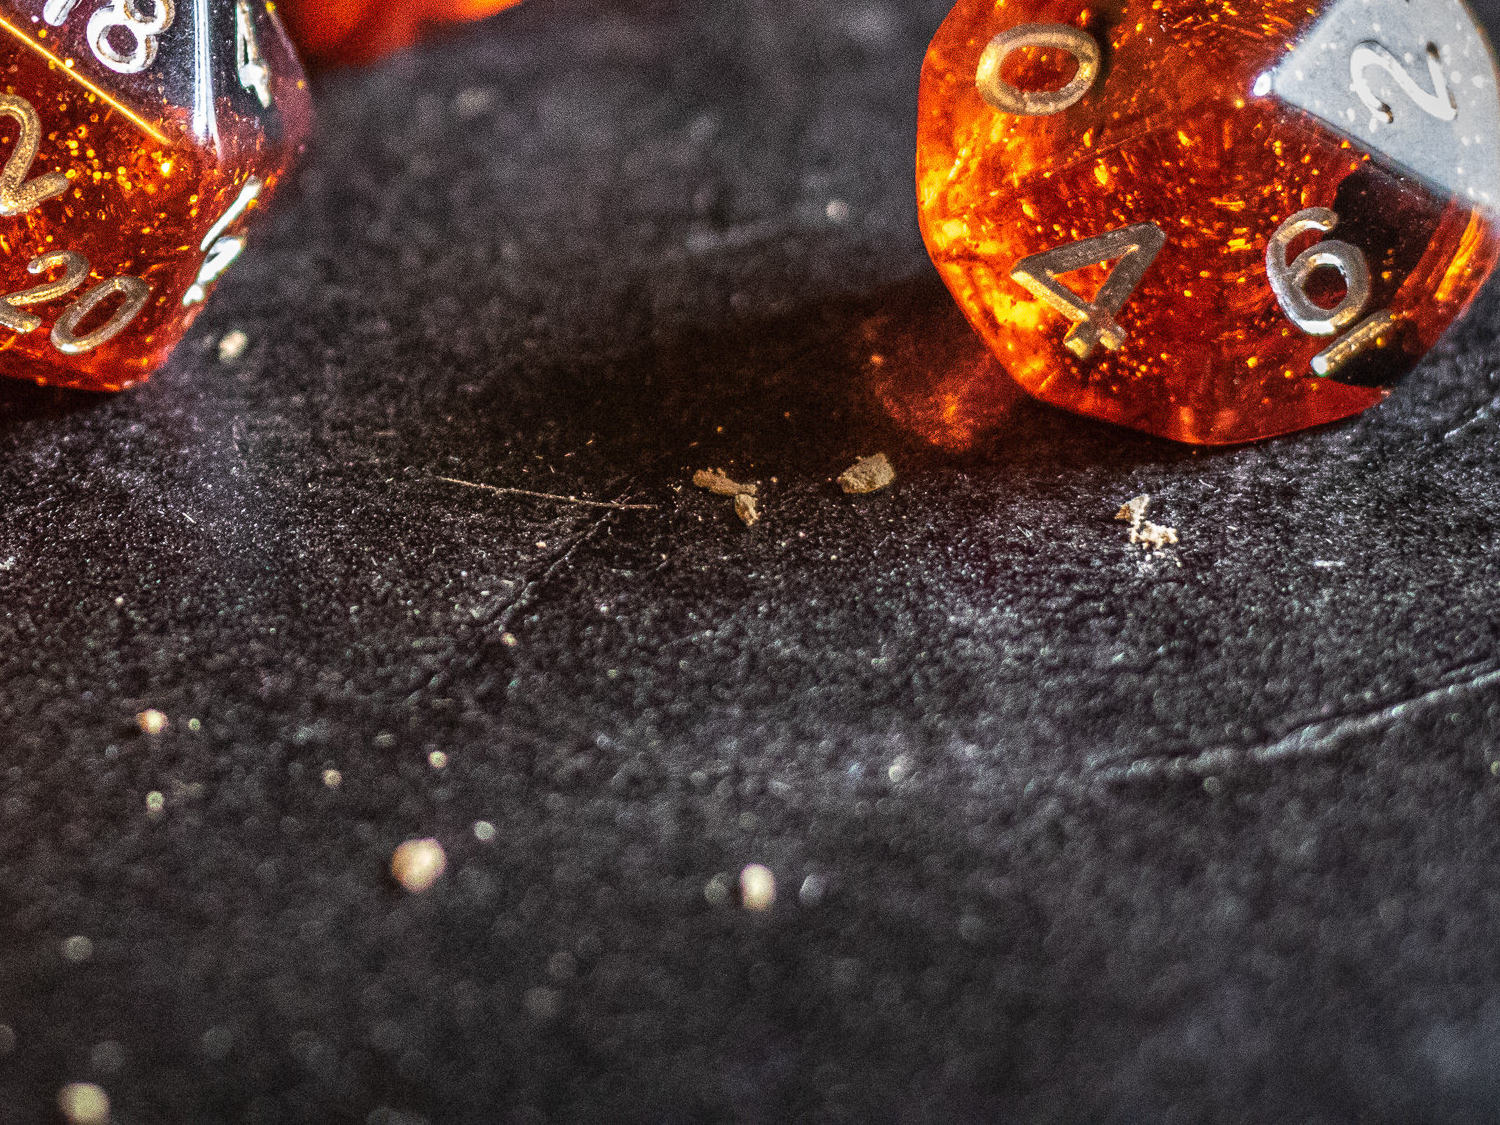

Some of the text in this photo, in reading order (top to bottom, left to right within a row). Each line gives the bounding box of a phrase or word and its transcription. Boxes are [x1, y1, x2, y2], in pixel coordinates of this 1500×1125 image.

[1350, 39, 1459, 125] 2
[1011, 220, 1167, 359] 4
[1266, 206, 1372, 337] 6
